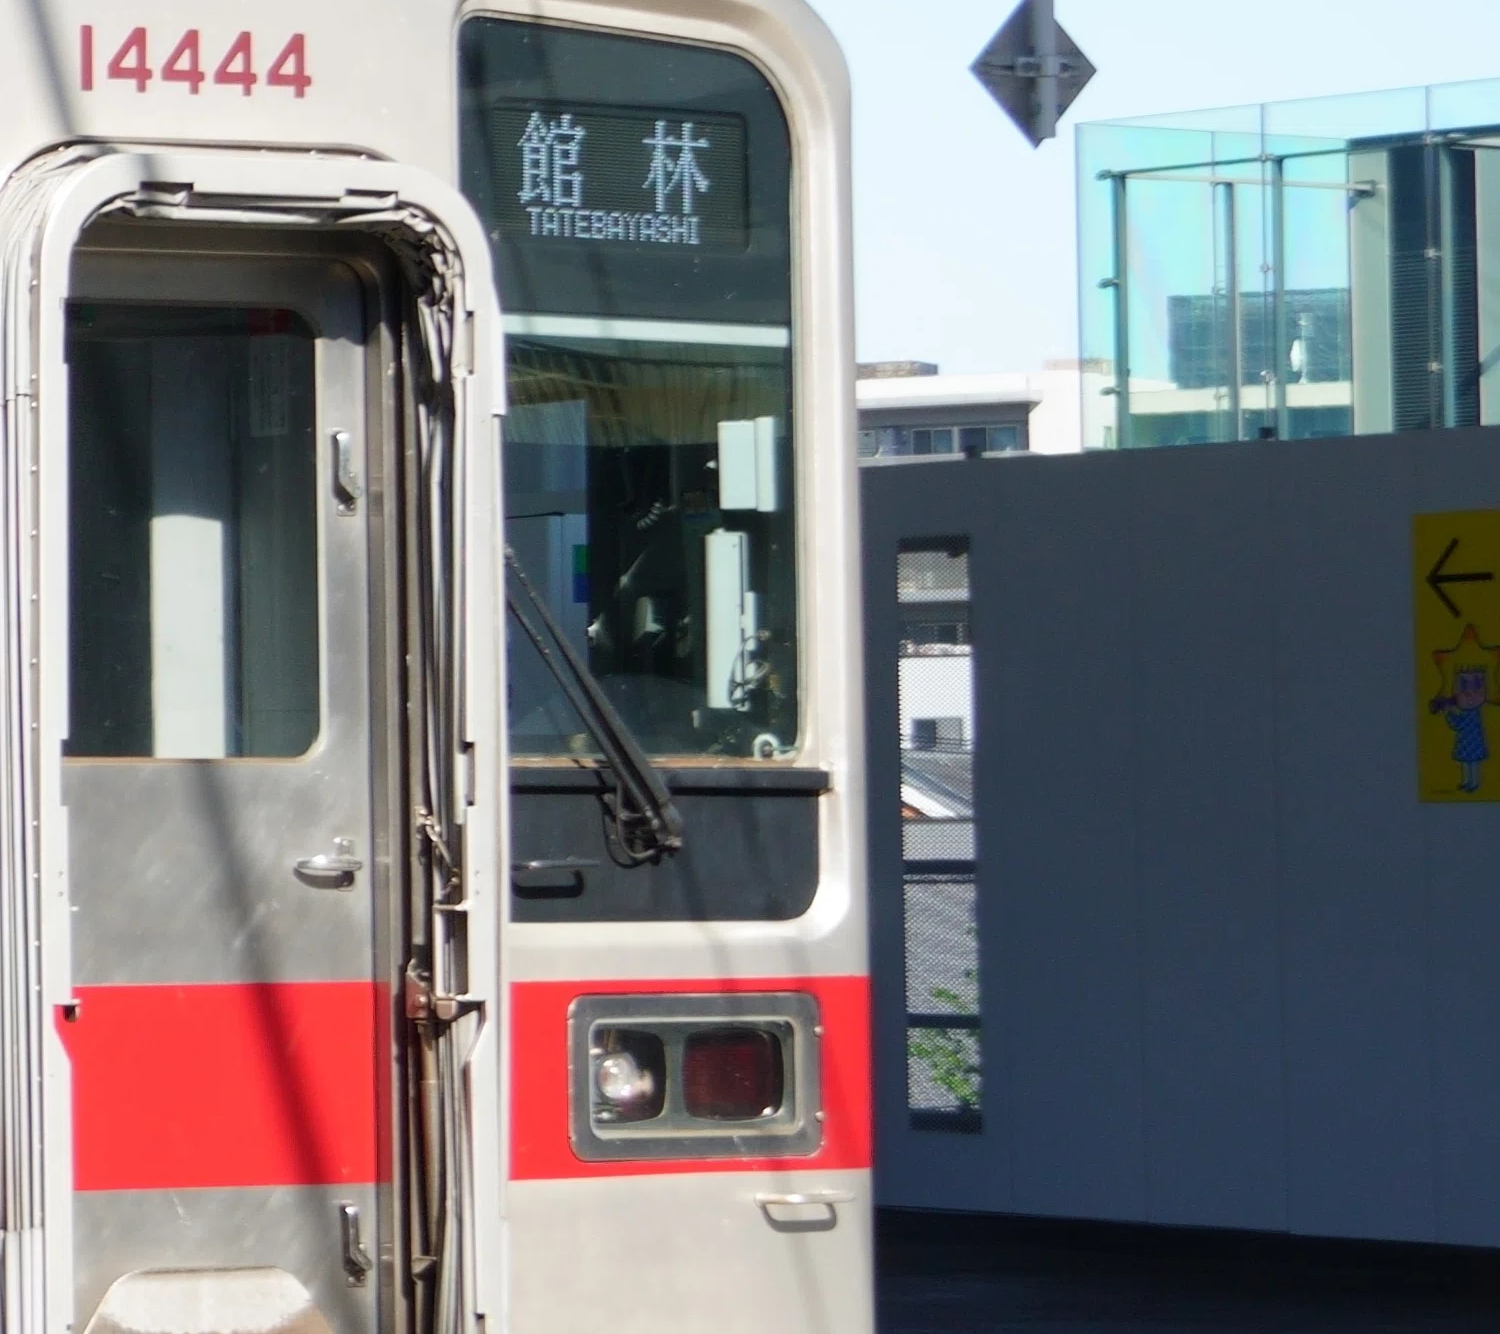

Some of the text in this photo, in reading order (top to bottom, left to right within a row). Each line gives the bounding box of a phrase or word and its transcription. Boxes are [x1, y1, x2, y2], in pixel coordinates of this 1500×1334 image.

[80, 24, 312, 99] 14444
[517, 111, 710, 214] 館林
[525, 205, 701, 245] TATEBAYASHI
